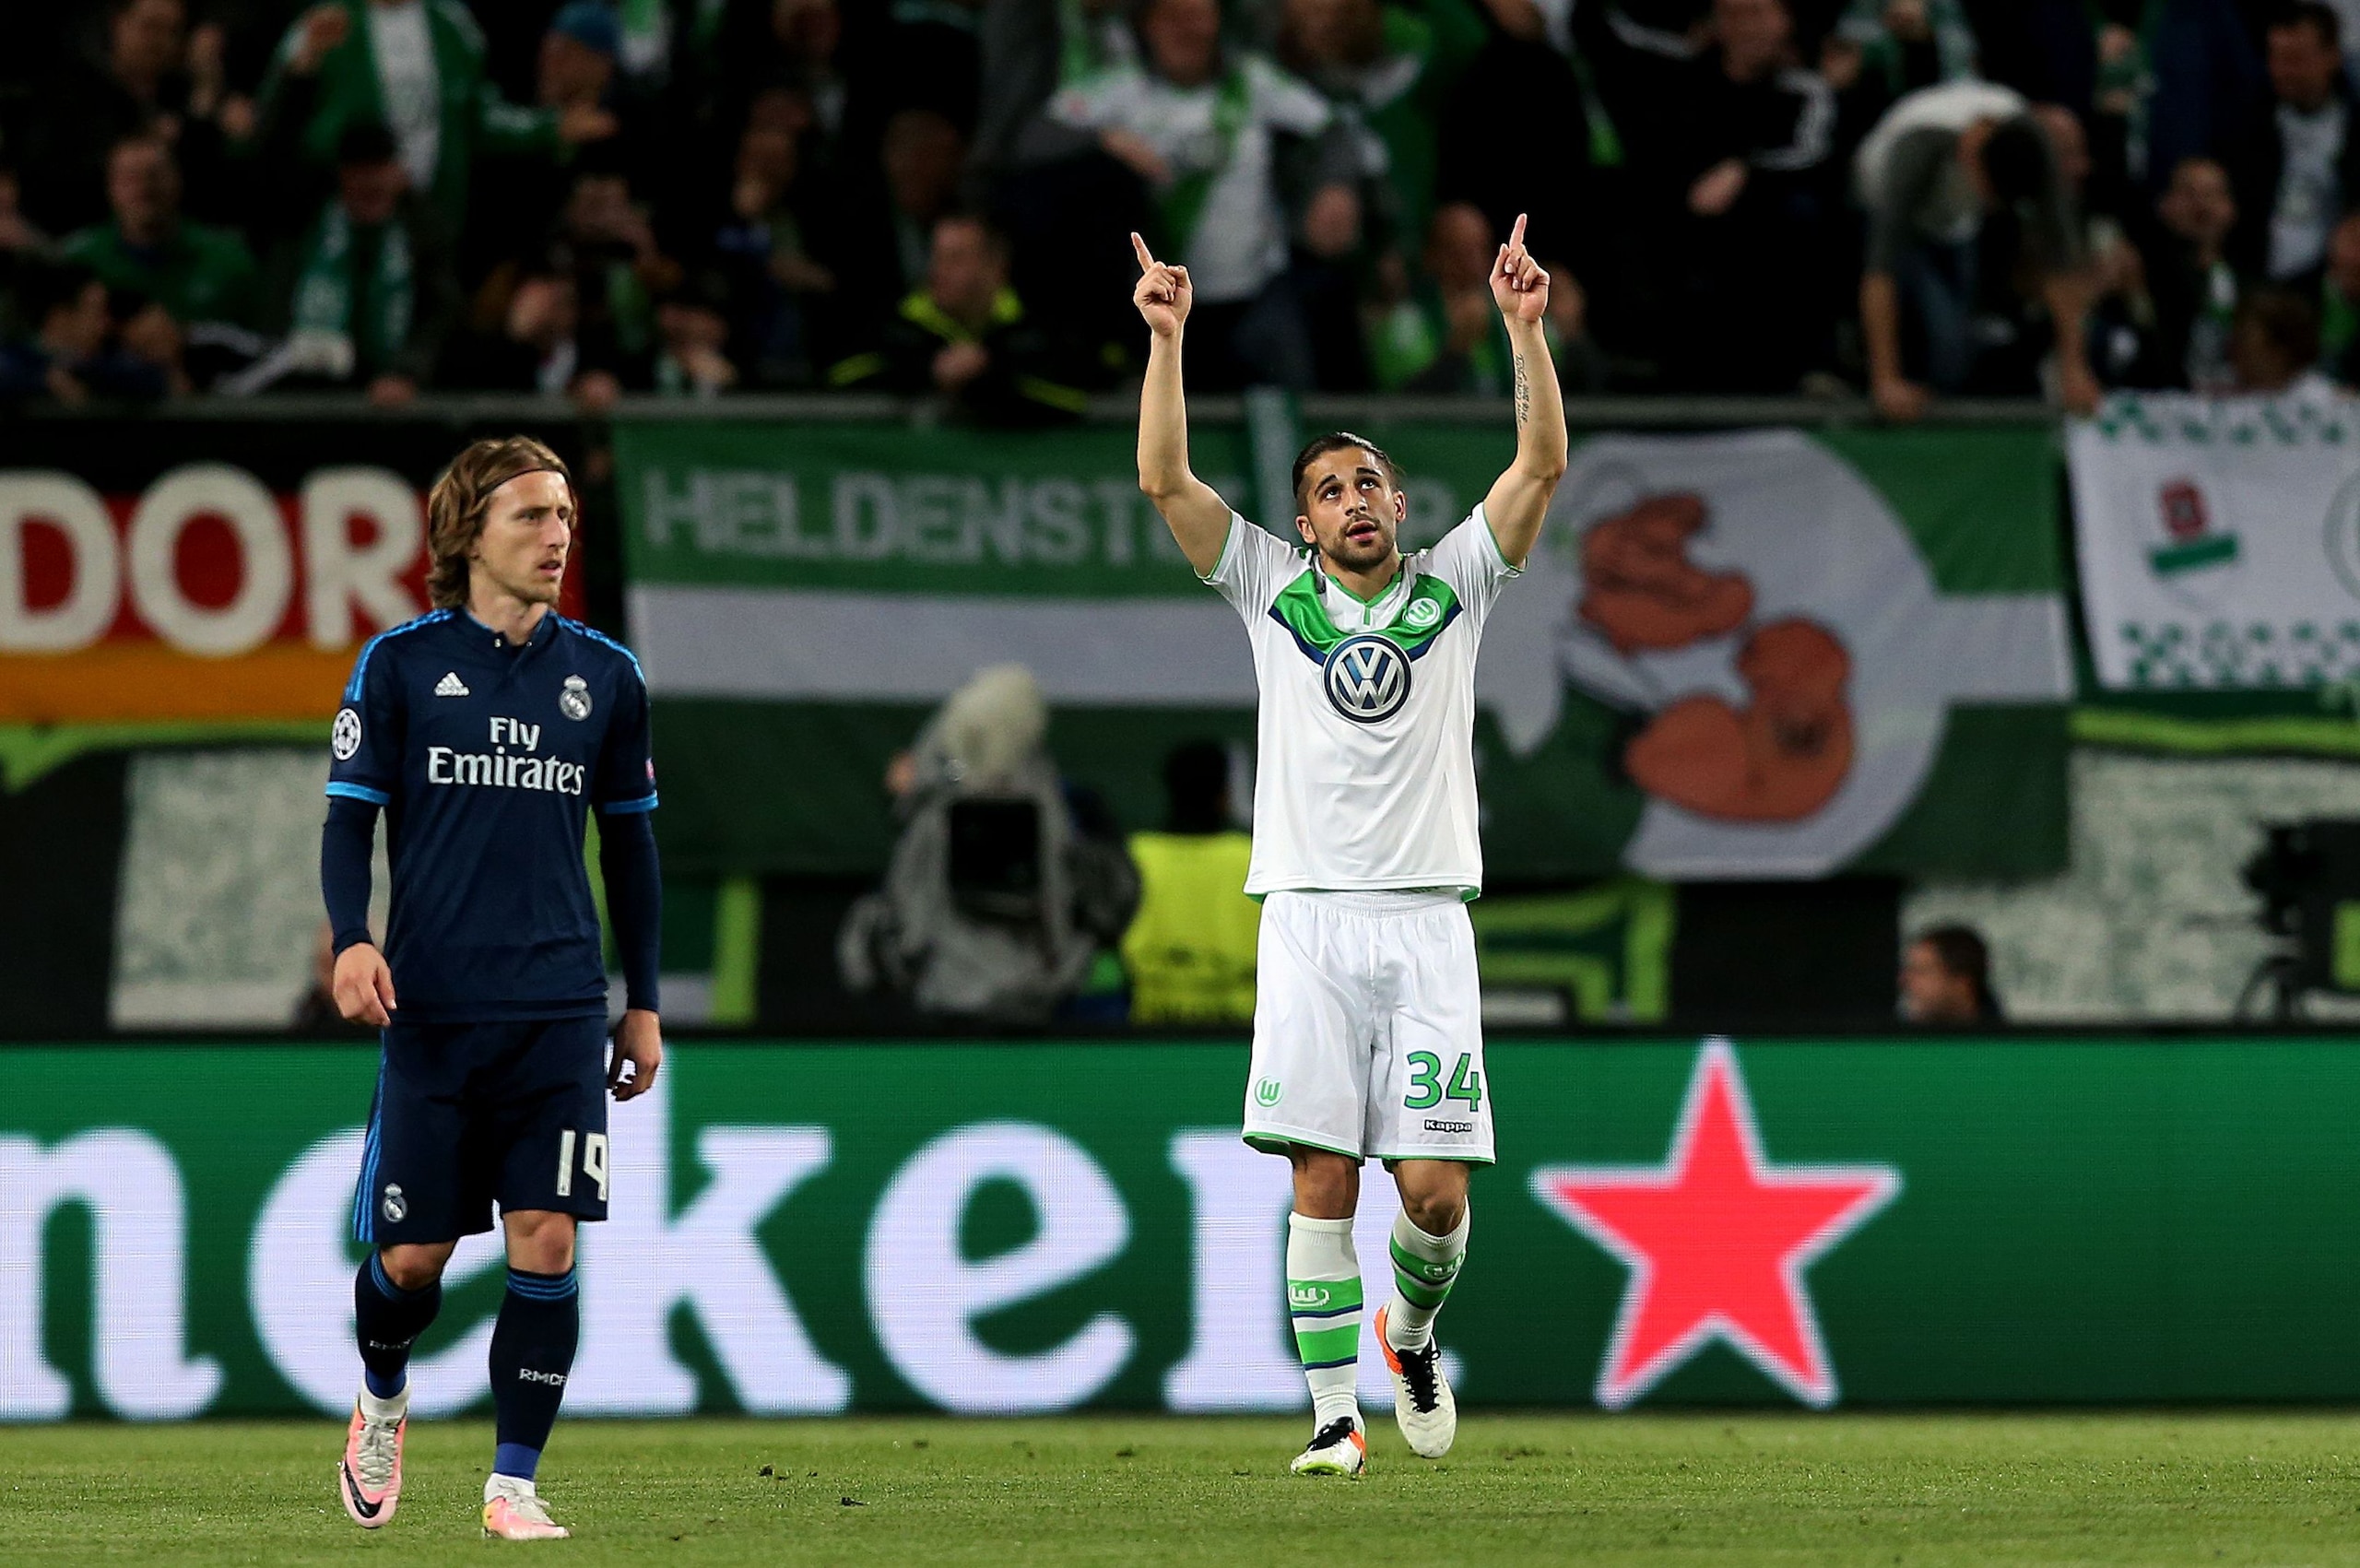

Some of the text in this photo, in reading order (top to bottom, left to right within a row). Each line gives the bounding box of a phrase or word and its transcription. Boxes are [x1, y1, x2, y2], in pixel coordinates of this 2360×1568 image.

[0, 463, 427, 658] DOR
[489, 716, 541, 752] Fly
[427, 745, 586, 796] Emirates
[1404, 1050, 1482, 1114] 34
[1424, 1119, 1472, 1133] Kappa
[556, 1128, 608, 1202] 19
